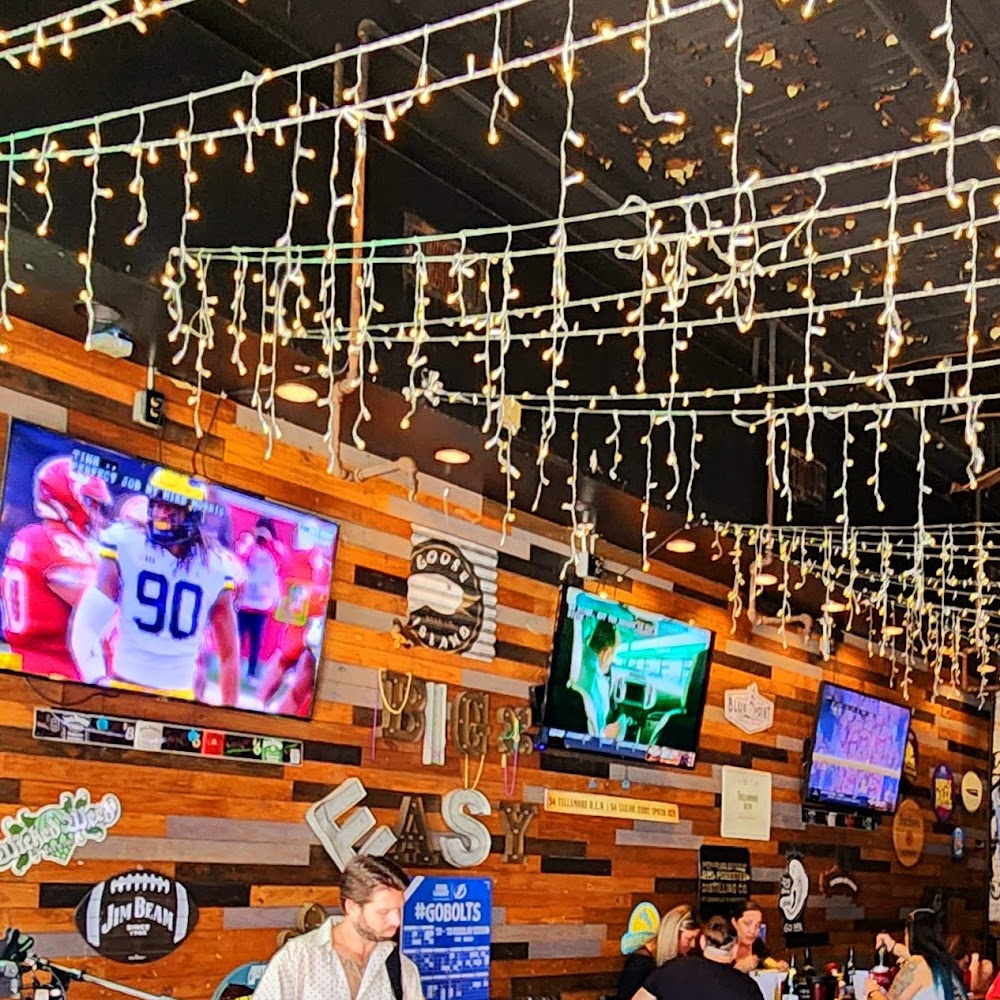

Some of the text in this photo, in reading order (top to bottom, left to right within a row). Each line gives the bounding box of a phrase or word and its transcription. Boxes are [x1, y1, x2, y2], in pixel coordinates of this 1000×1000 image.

[416, 549, 469, 583] GOOSE
[133, 569, 202, 640] 90
[412, 616, 470, 649] ISLAND
[375, 668, 489, 766] BIG
[728, 696, 748, 713] BLUE
[305, 777, 538, 873] EASY
[101, 896, 174, 935] JIM BEAM
[414, 901, 481, 923] #GOBOLTS
